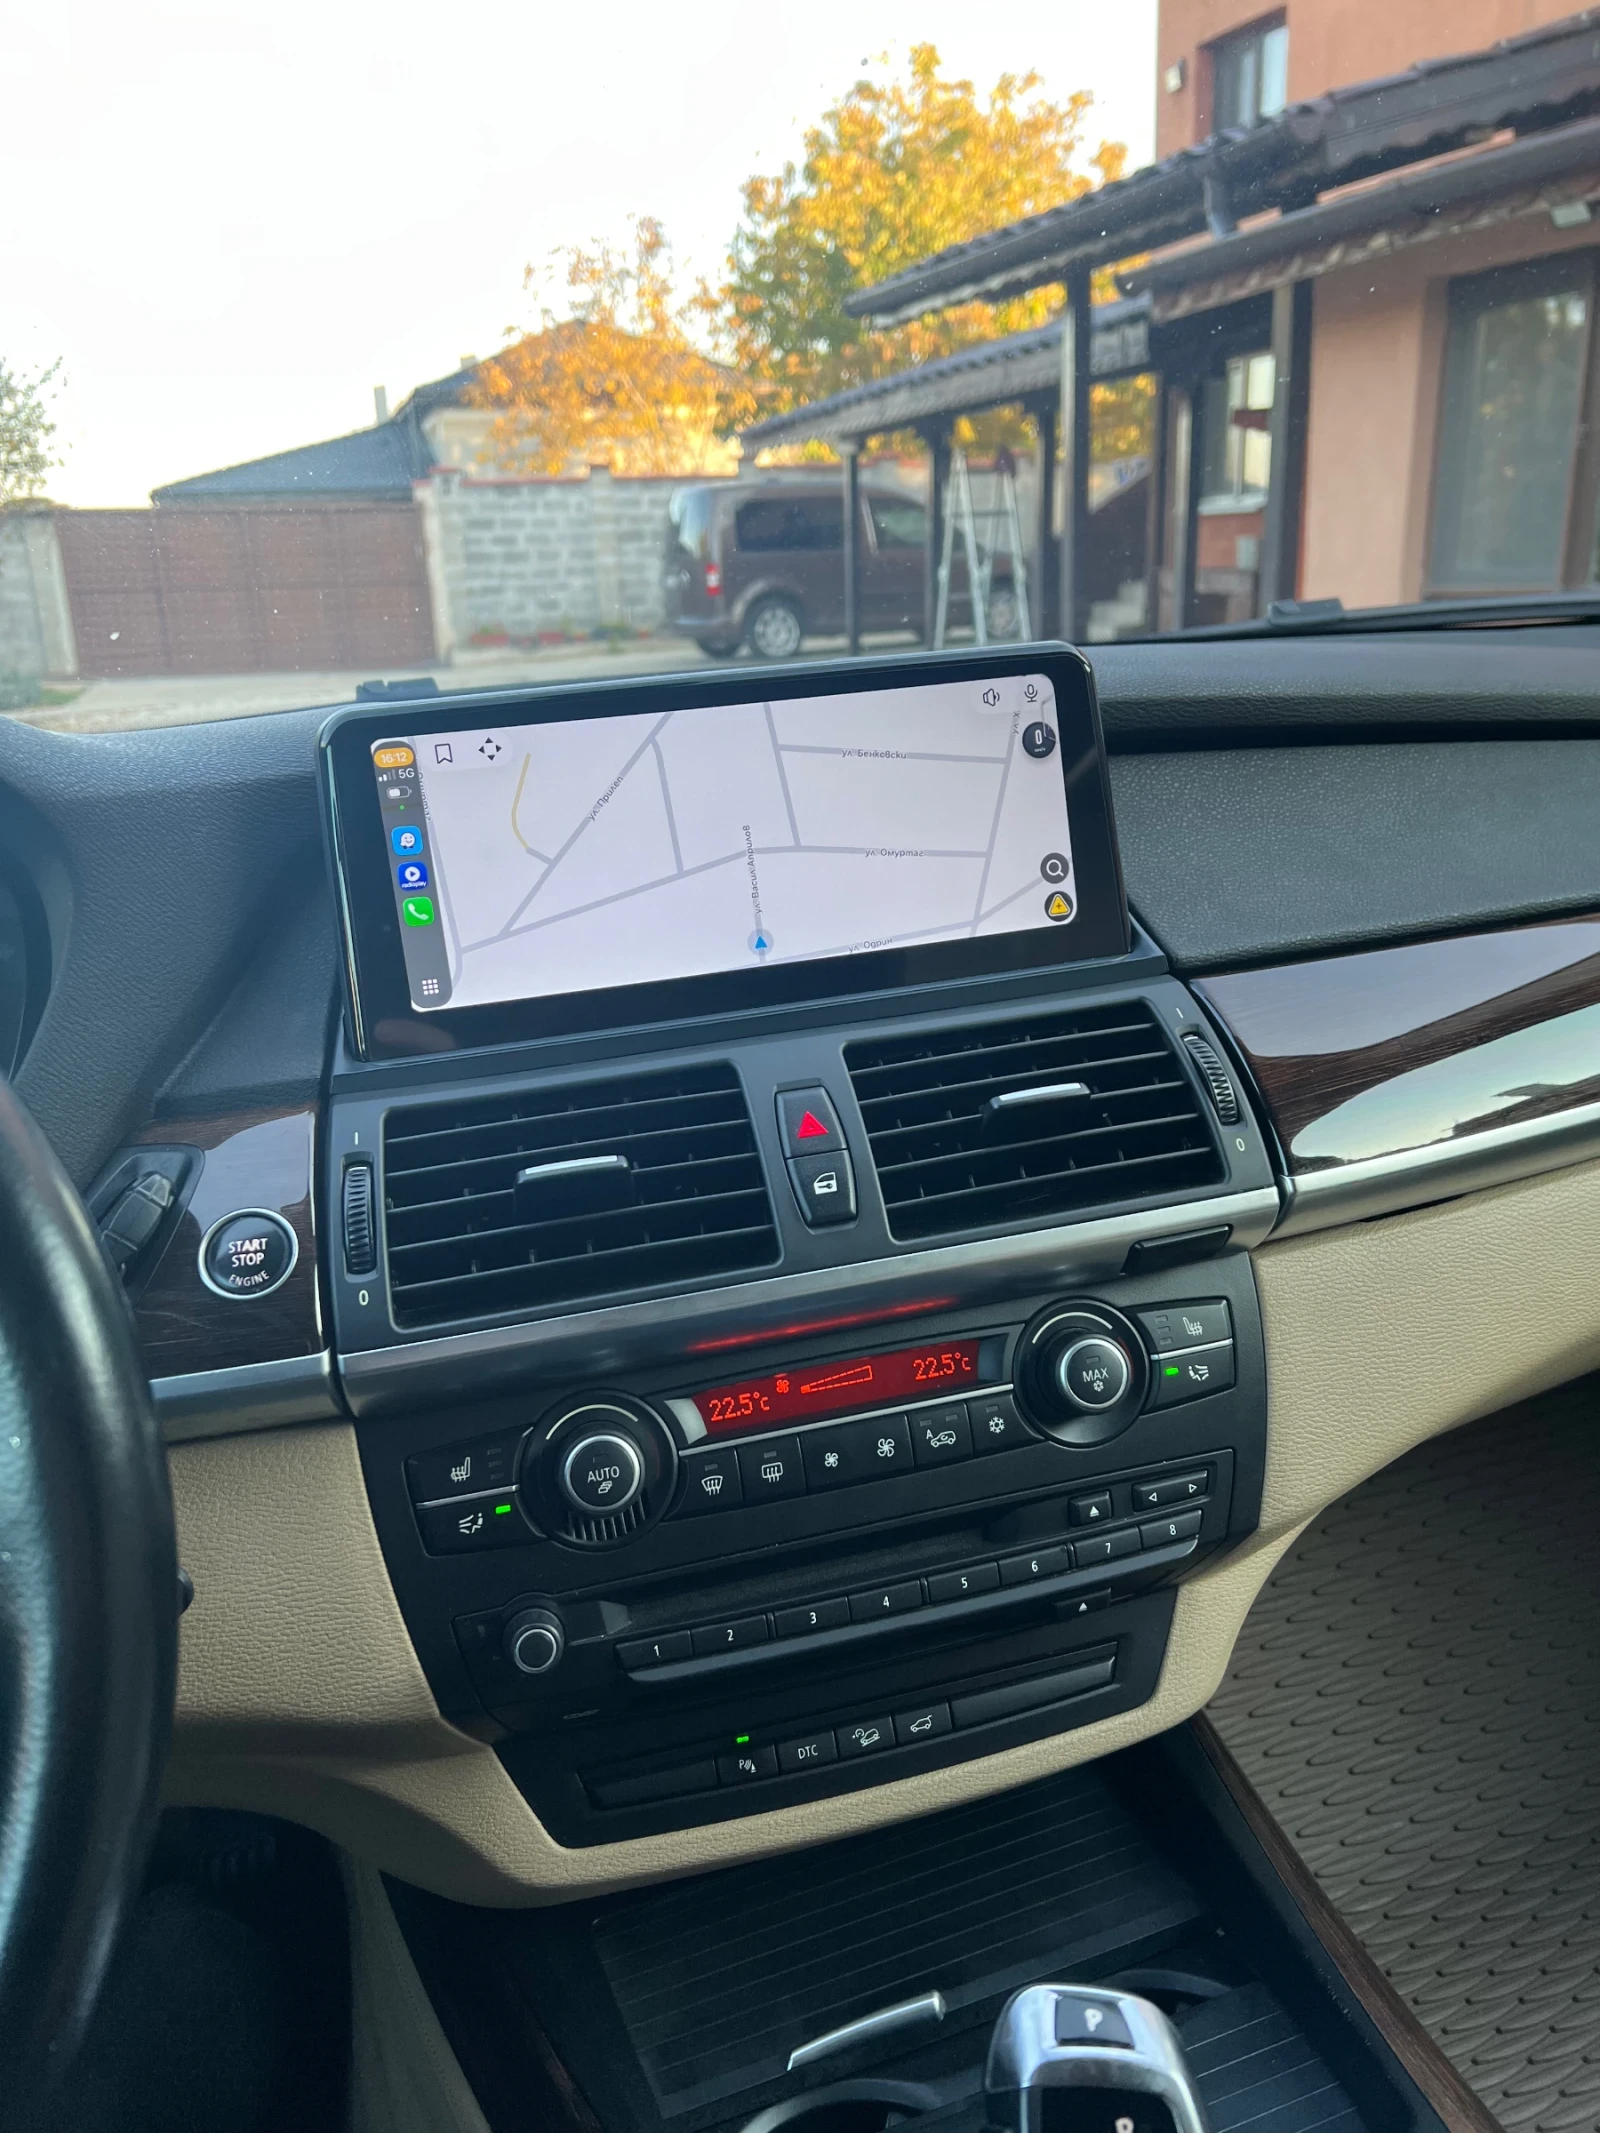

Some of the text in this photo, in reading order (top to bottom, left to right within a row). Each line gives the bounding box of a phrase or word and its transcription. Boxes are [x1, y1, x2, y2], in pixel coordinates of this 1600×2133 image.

[1034, 729, 1043, 745] 0
[380, 751, 408, 764] 16:12
[857, 748, 907, 759] Бенковски
[398, 767, 415, 779] 5G
[596, 776, 624, 807] Прилеп
[742, 824, 756, 867] Априлов
[880, 848, 924, 858] Омуртаг
[863, 938, 893, 949] Одрин
[228, 1237, 269, 1254] START
[231, 1252, 265, 1268] STOP
[228, 1269, 270, 1287] ENGINE
[1082, 1367, 1109, 1383] MAX
[587, 1465, 620, 1483] AUTO
[1169, 1524, 1176, 1536] 8
[1105, 1542, 1111, 1554] 7
[1031, 1560, 1039, 1572] 6
[961, 1577, 968, 1589] 5
[882, 1595, 890, 1608] 4
[809, 1612, 817, 1624] 3
[727, 1629, 734, 1641] 2
[653, 1644, 662, 1658] 1
[797, 1744, 819, 1760] DTC
[1083, 2007, 1104, 2032] P
